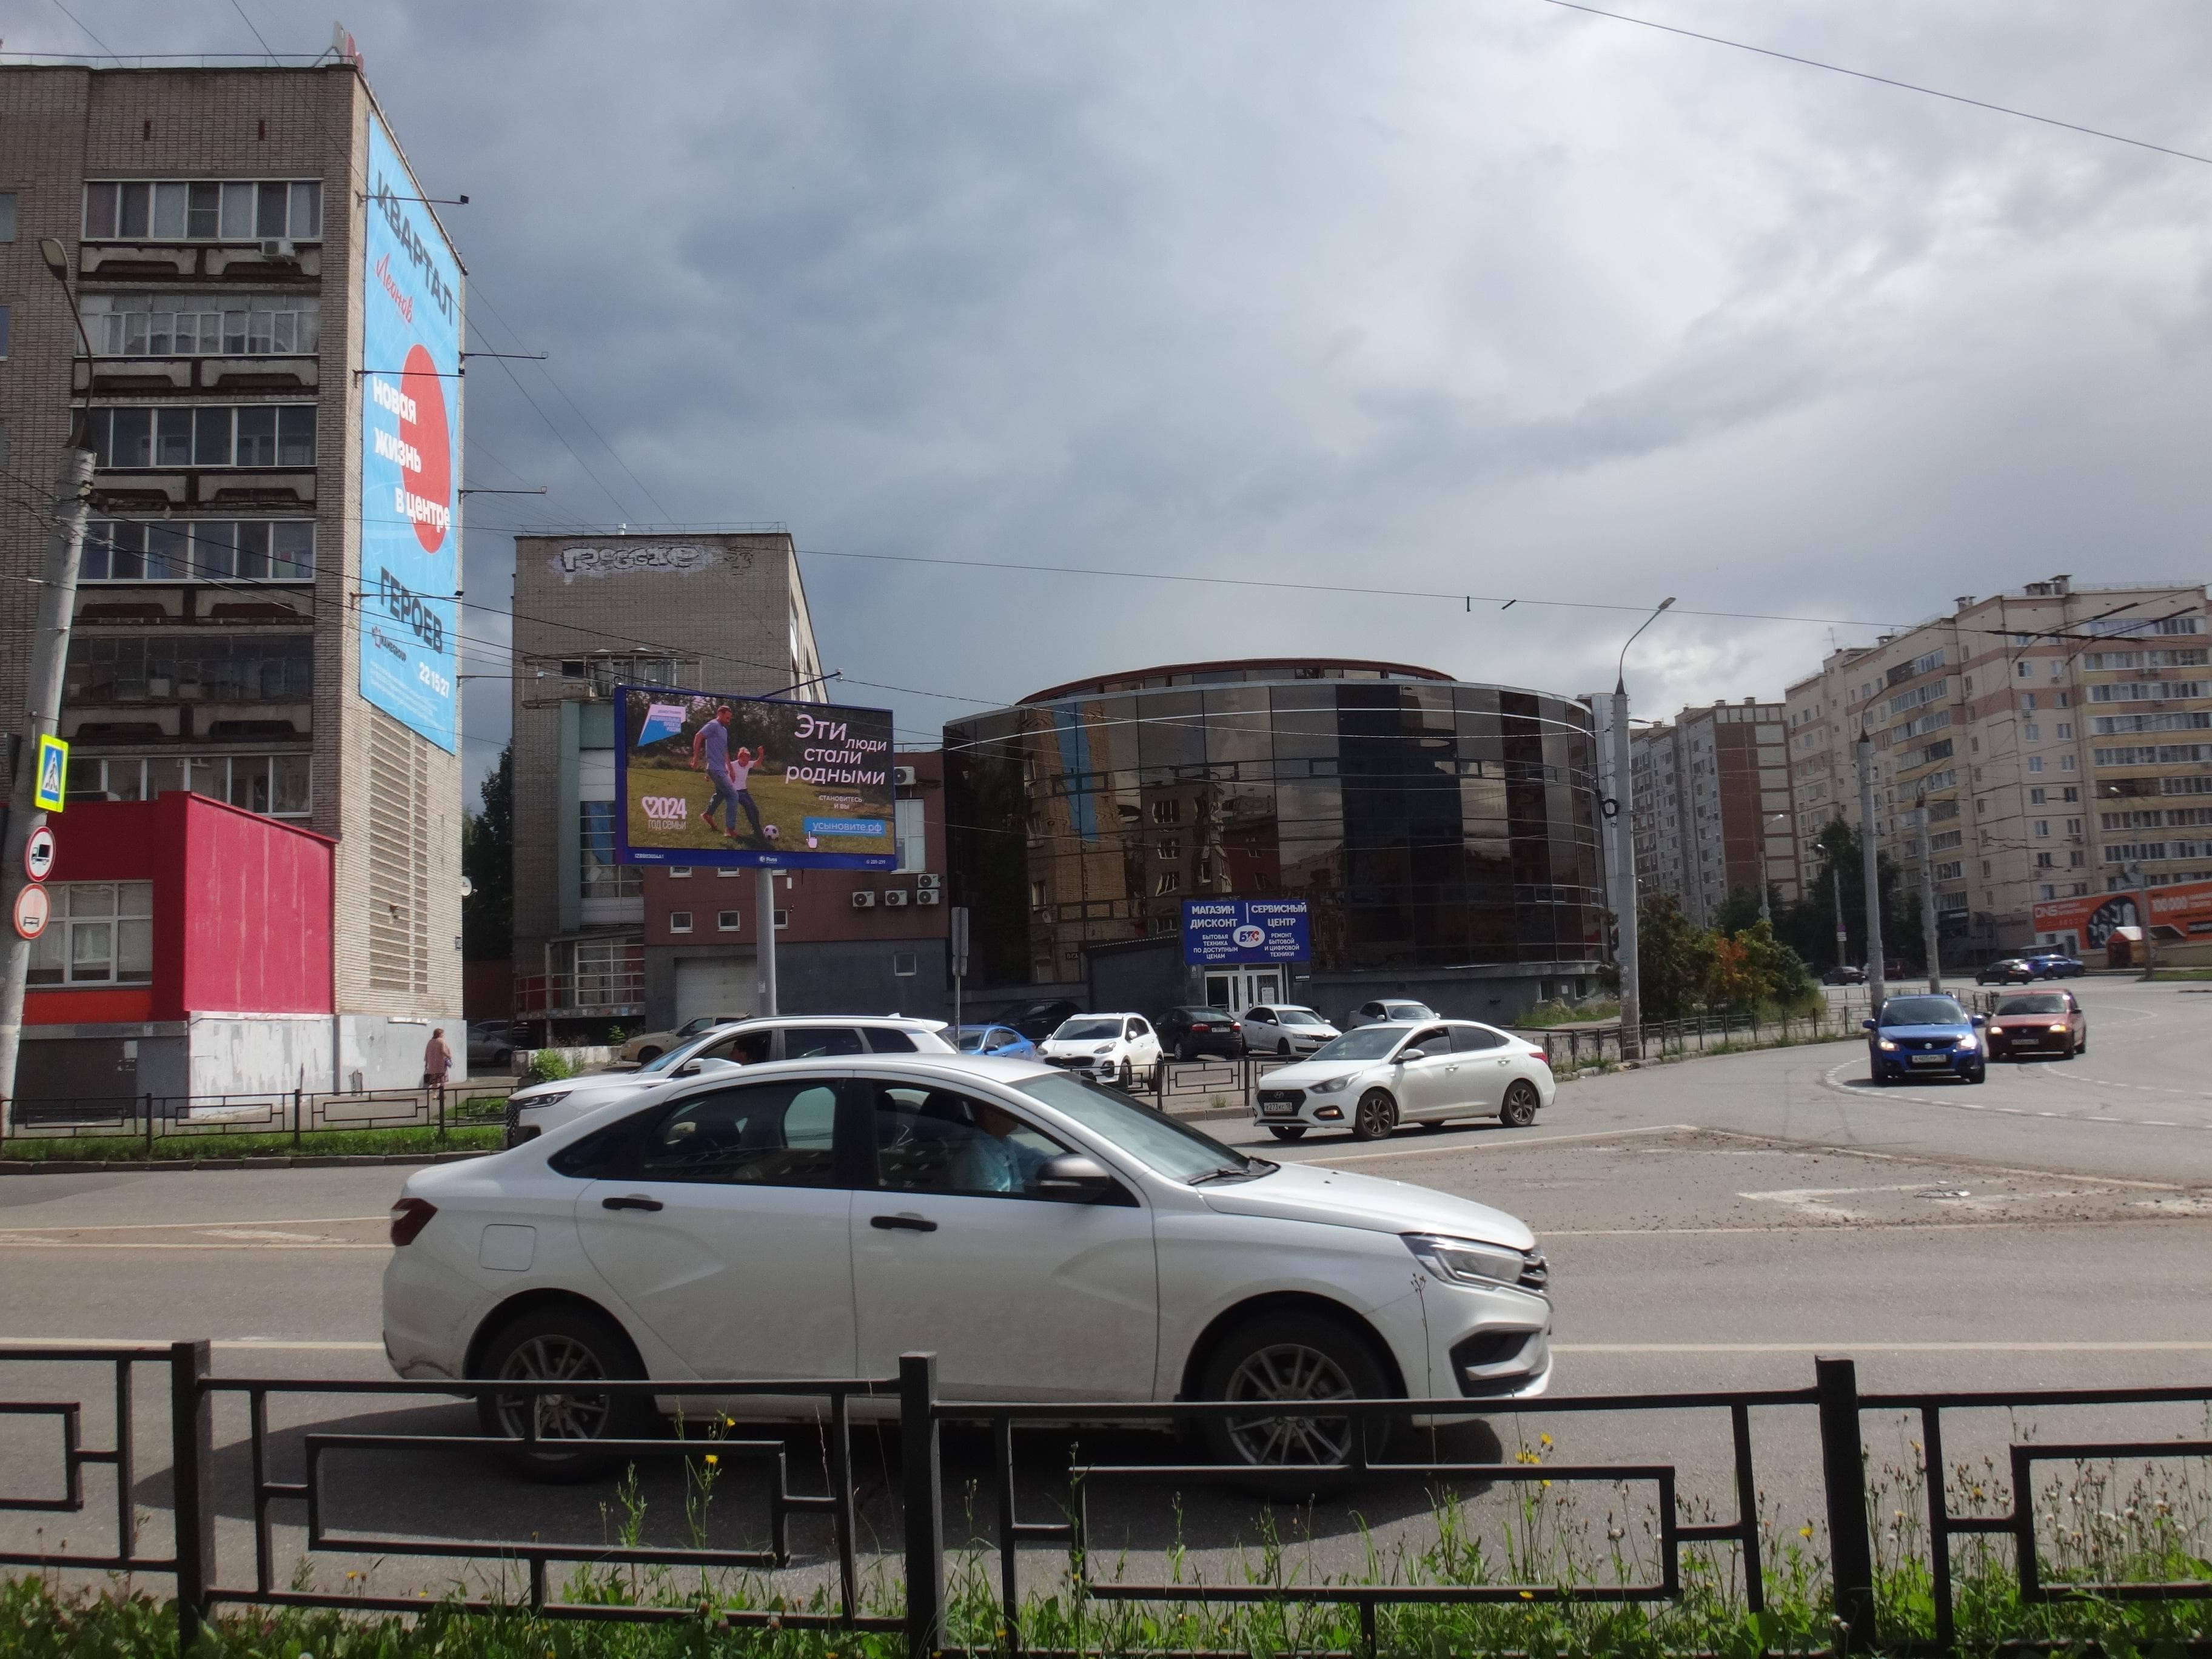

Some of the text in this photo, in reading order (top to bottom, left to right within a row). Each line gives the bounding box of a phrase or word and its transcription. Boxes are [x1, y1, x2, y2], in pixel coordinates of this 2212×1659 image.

[378, 169, 452, 326] КВАРТАЛ
[406, 492, 451, 532] центре
[380, 566, 443, 654] ГЕРОЕВ
[794, 714, 887, 752] Эти люди
[804, 748, 862, 764] стали
[785, 766, 885, 785] родными
[648, 796, 687, 819] 2024
[813, 822, 882, 834] усыновите.рф
[1191, 906, 1235, 914] МАГАЗИН
[1251, 902, 1307, 913] СЕРВИСНЫЙ
[1190, 919, 1238, 929] ДИСКОНТ
[1267, 918, 1296, 928] ЦЕНТР
